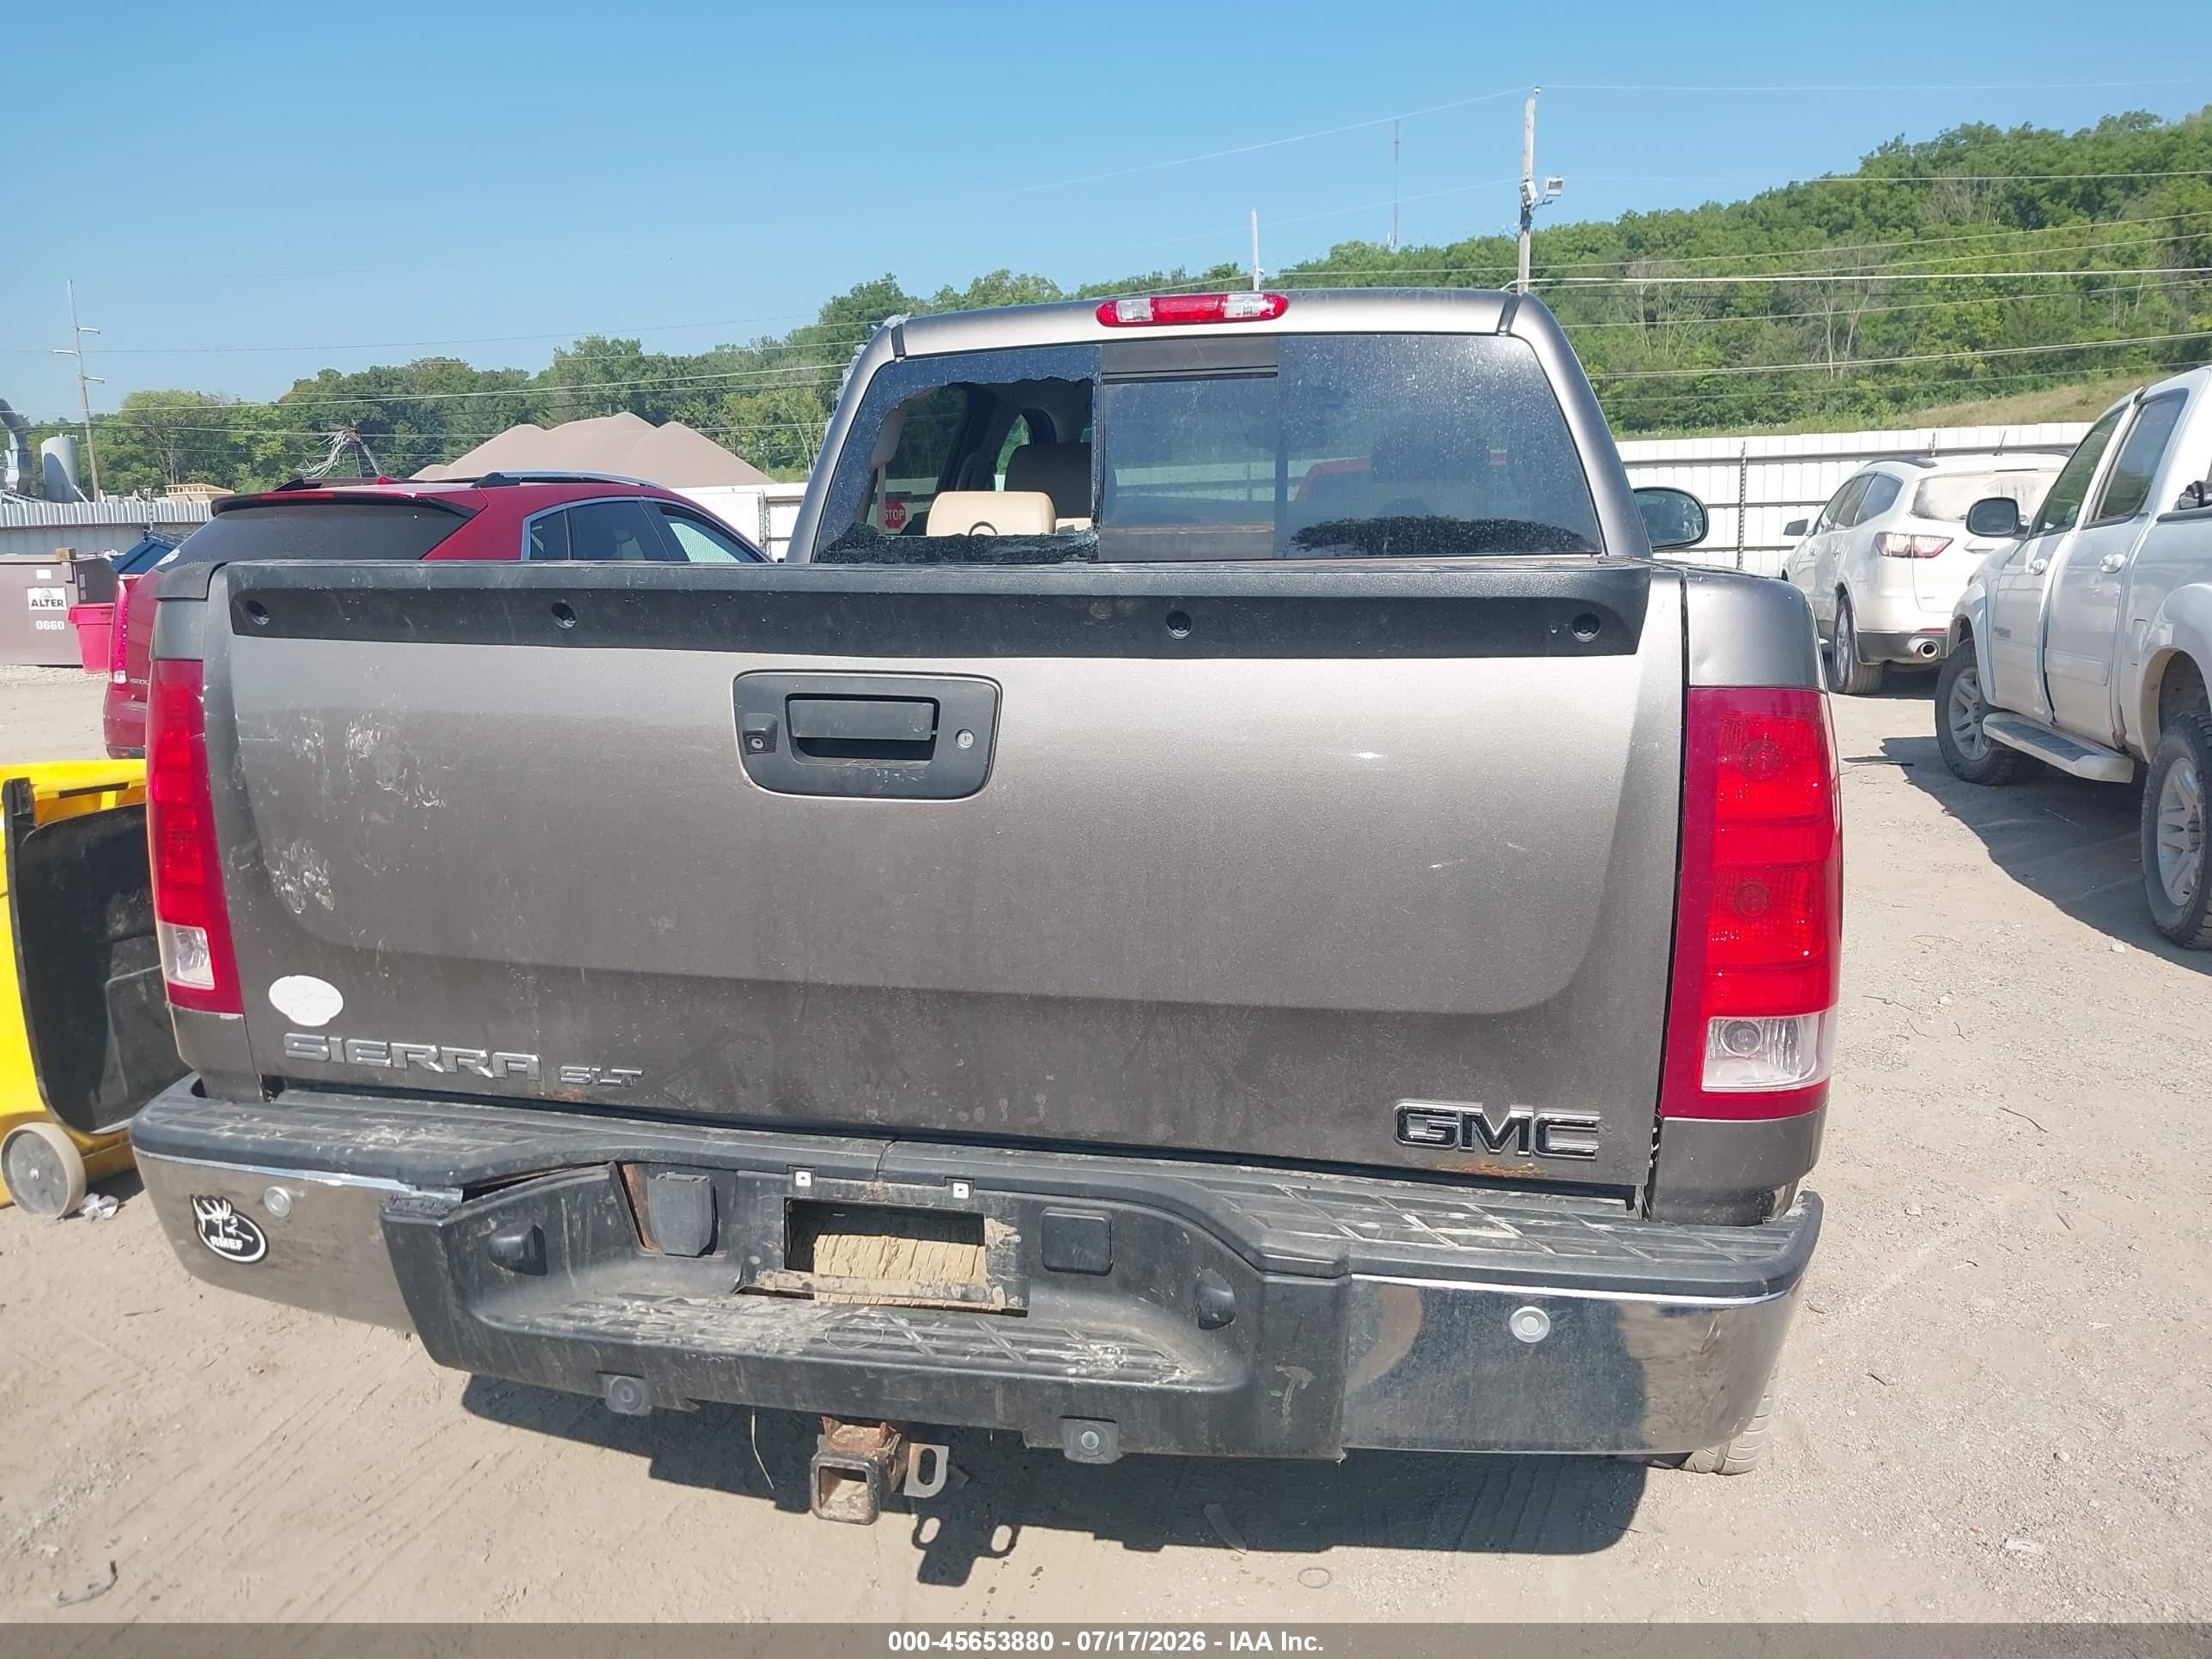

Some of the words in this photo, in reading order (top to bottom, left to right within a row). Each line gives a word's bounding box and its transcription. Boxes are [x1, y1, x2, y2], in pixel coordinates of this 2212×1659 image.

[31, 599, 64, 607] ALTER
[36, 620, 65, 630] 0660
[283, 1032, 544, 1082] SIERRA
[560, 1065, 643, 1087] SLT
[1394, 1099, 1601, 1159] GMC
